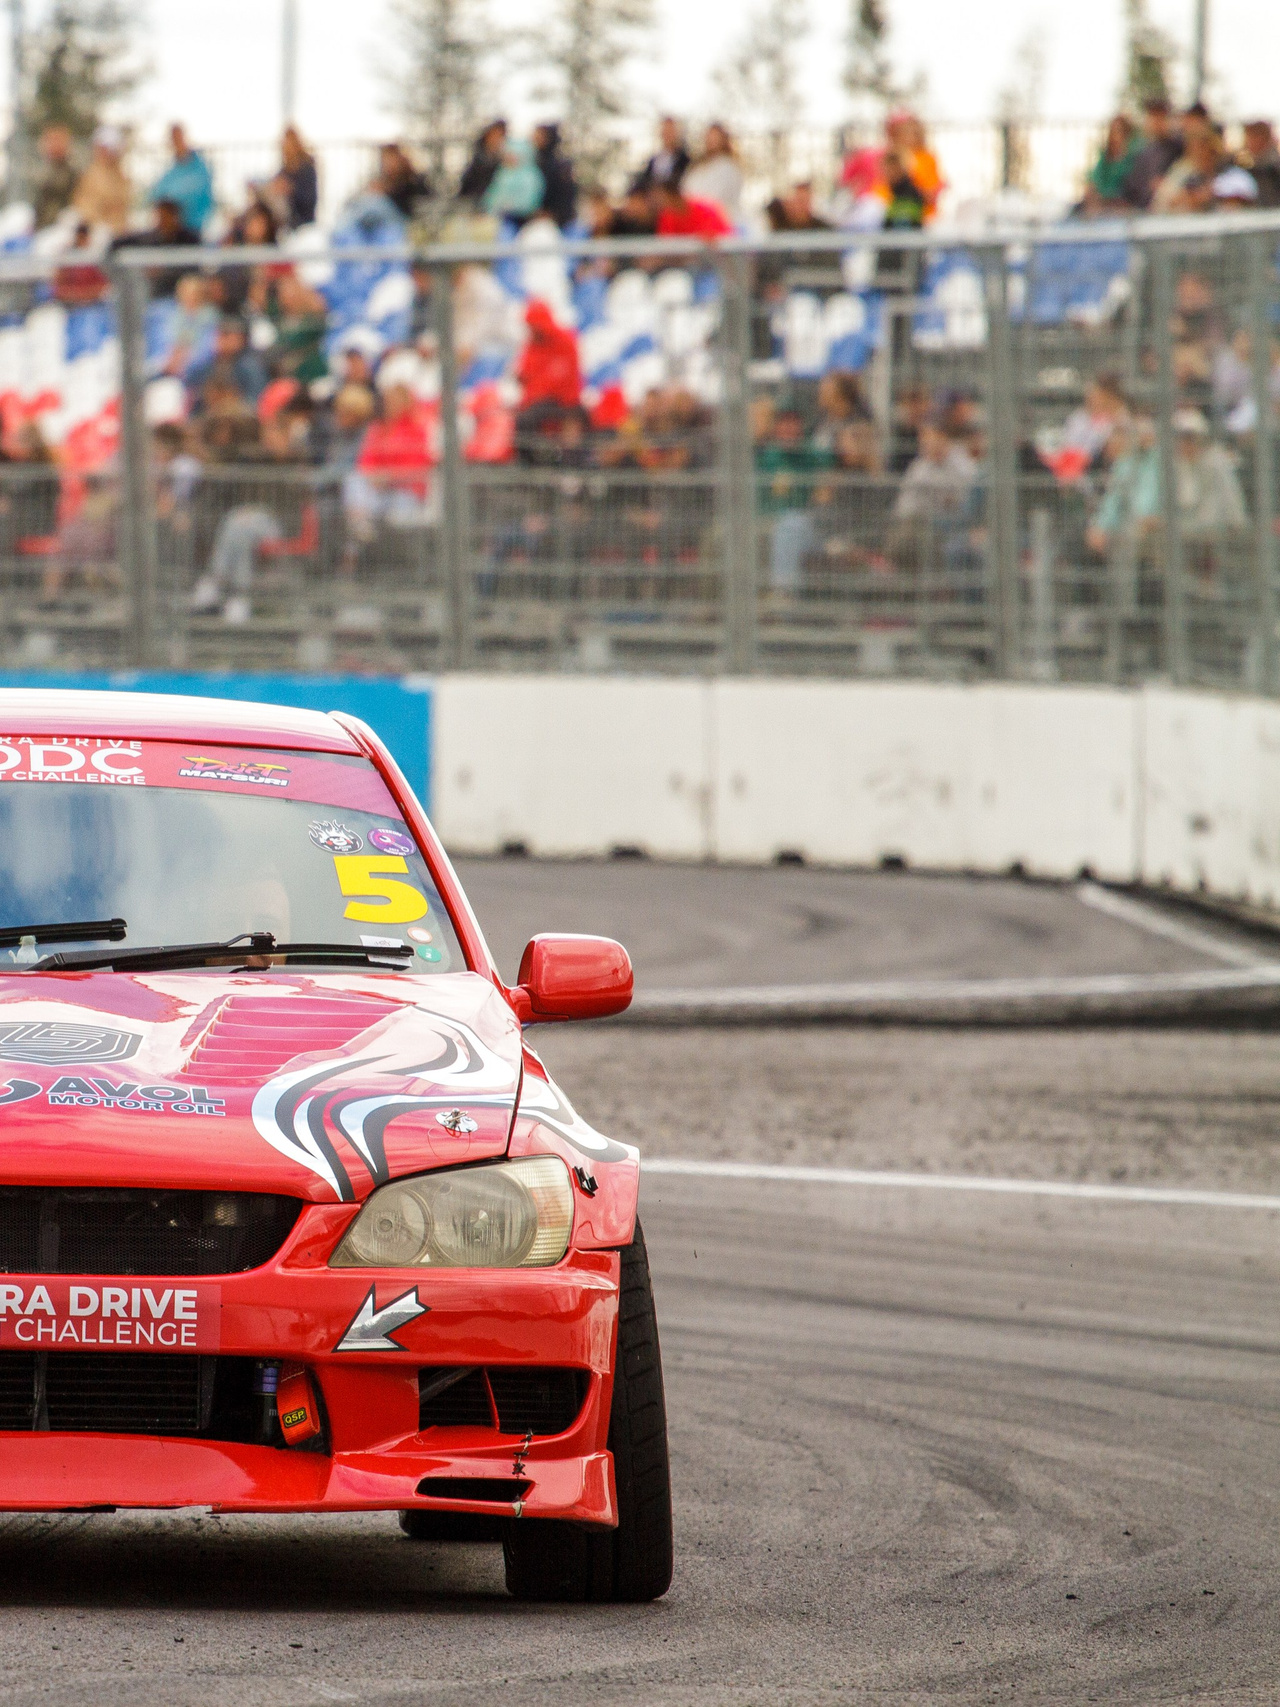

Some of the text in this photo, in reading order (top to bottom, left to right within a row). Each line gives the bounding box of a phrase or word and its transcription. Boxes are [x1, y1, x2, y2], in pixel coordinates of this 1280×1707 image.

[12, 771, 146, 785] CHALLENGE
[180, 769, 288, 786] MATSURI
[333, 855, 428, 924] 5
[46, 1076, 226, 1106] AVOL
[48, 1095, 226, 1116] MOTOR OIL
[69, 1286, 198, 1320] DRIVE
[15, 1318, 197, 1347] CHALLENGE
[284, 1410, 304, 1424] QSP
